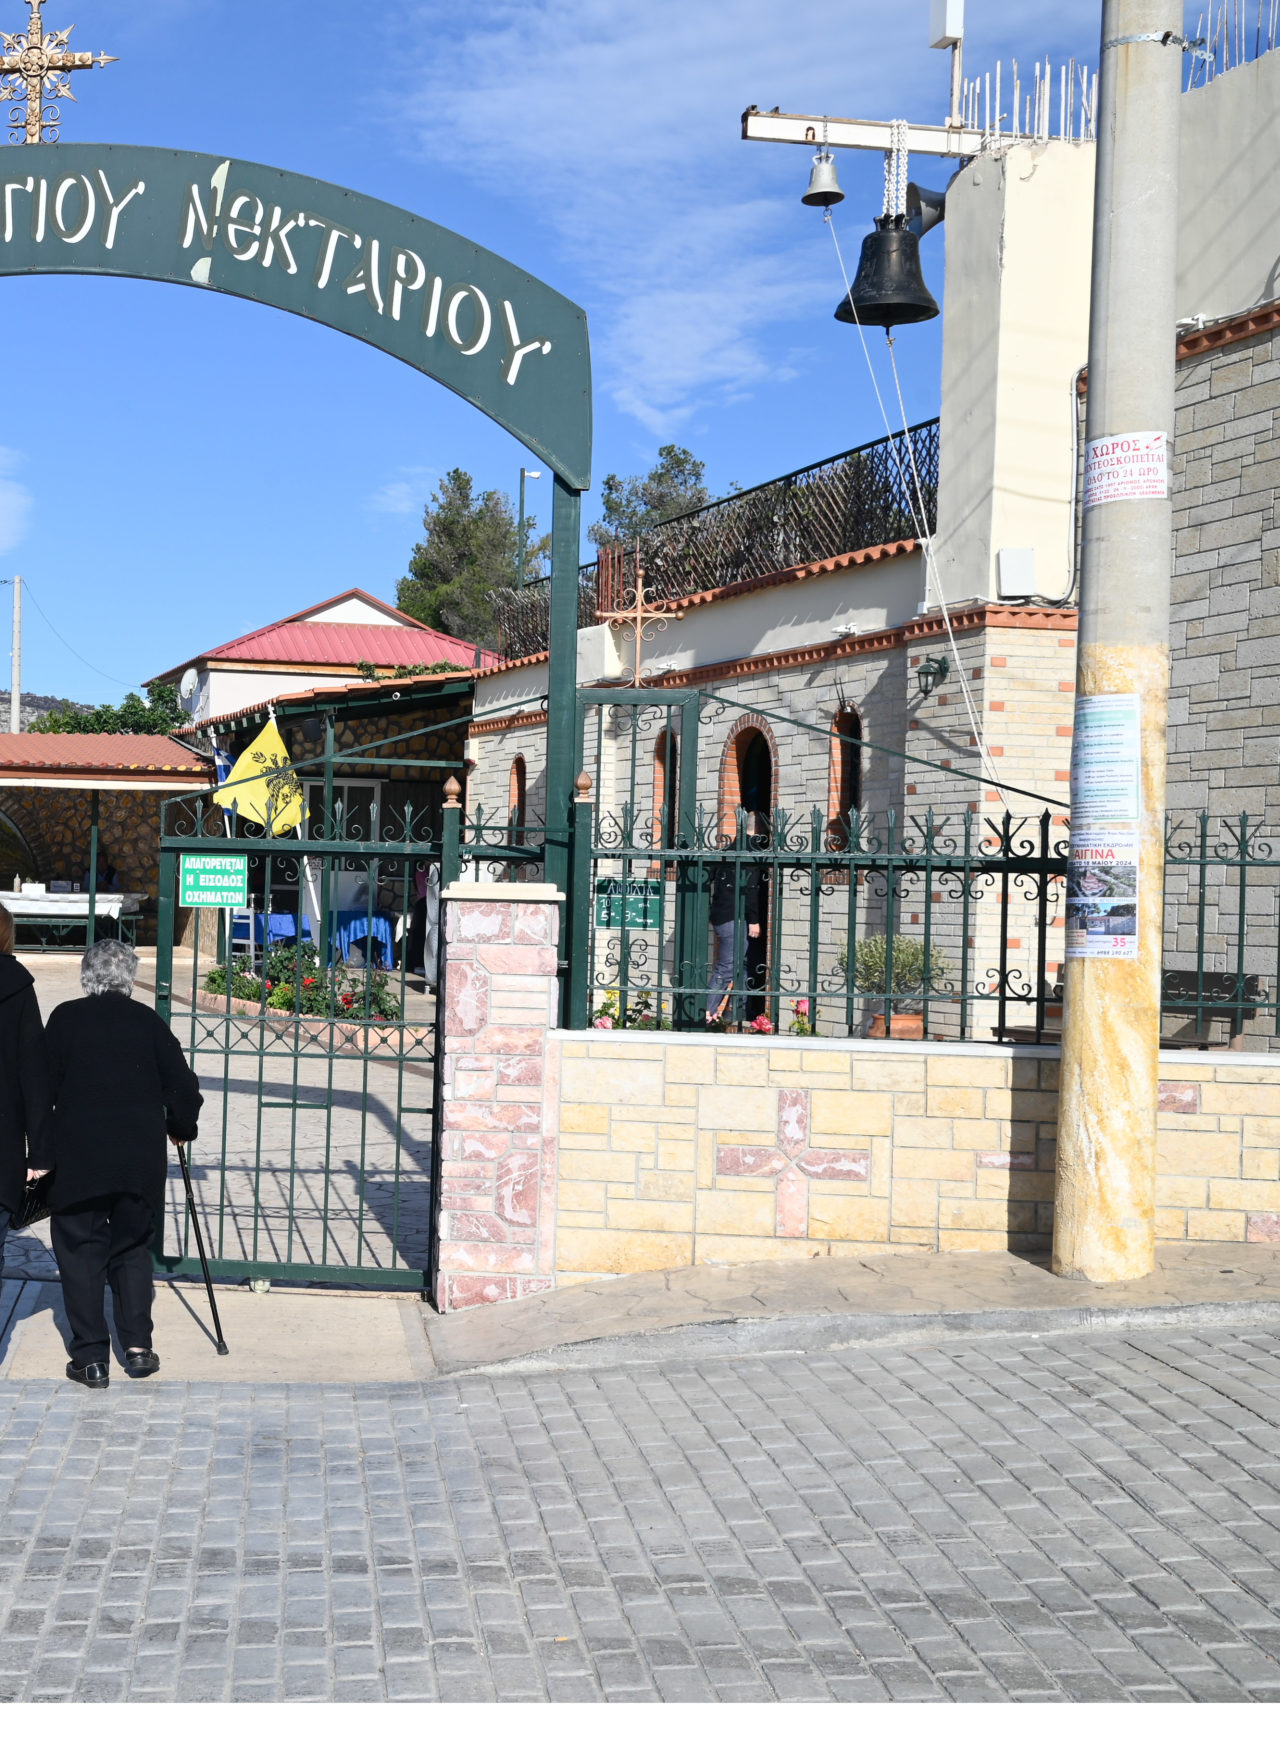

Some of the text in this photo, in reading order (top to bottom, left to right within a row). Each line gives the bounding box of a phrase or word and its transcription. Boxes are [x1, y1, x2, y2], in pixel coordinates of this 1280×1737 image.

[1092, 440, 1141, 459] ΧΩΡΟΣ
[1084, 453, 1165, 474] ΙΝΤΕΟΣΚΟΠΕΙΤΑΙ
[1138, 466, 1159, 476] ΩΡΟ
[1074, 848, 1115, 860] ΑΙΓΙΝΑ
[185, 857, 243, 870] ΑΠΑΓΟΡΕΥΕΤΑΙ
[186, 874, 243, 886] Η ΕΙΣΟΔΟΣ
[185, 891, 243, 903] ΟΧΗΜΑΤΩΝ
